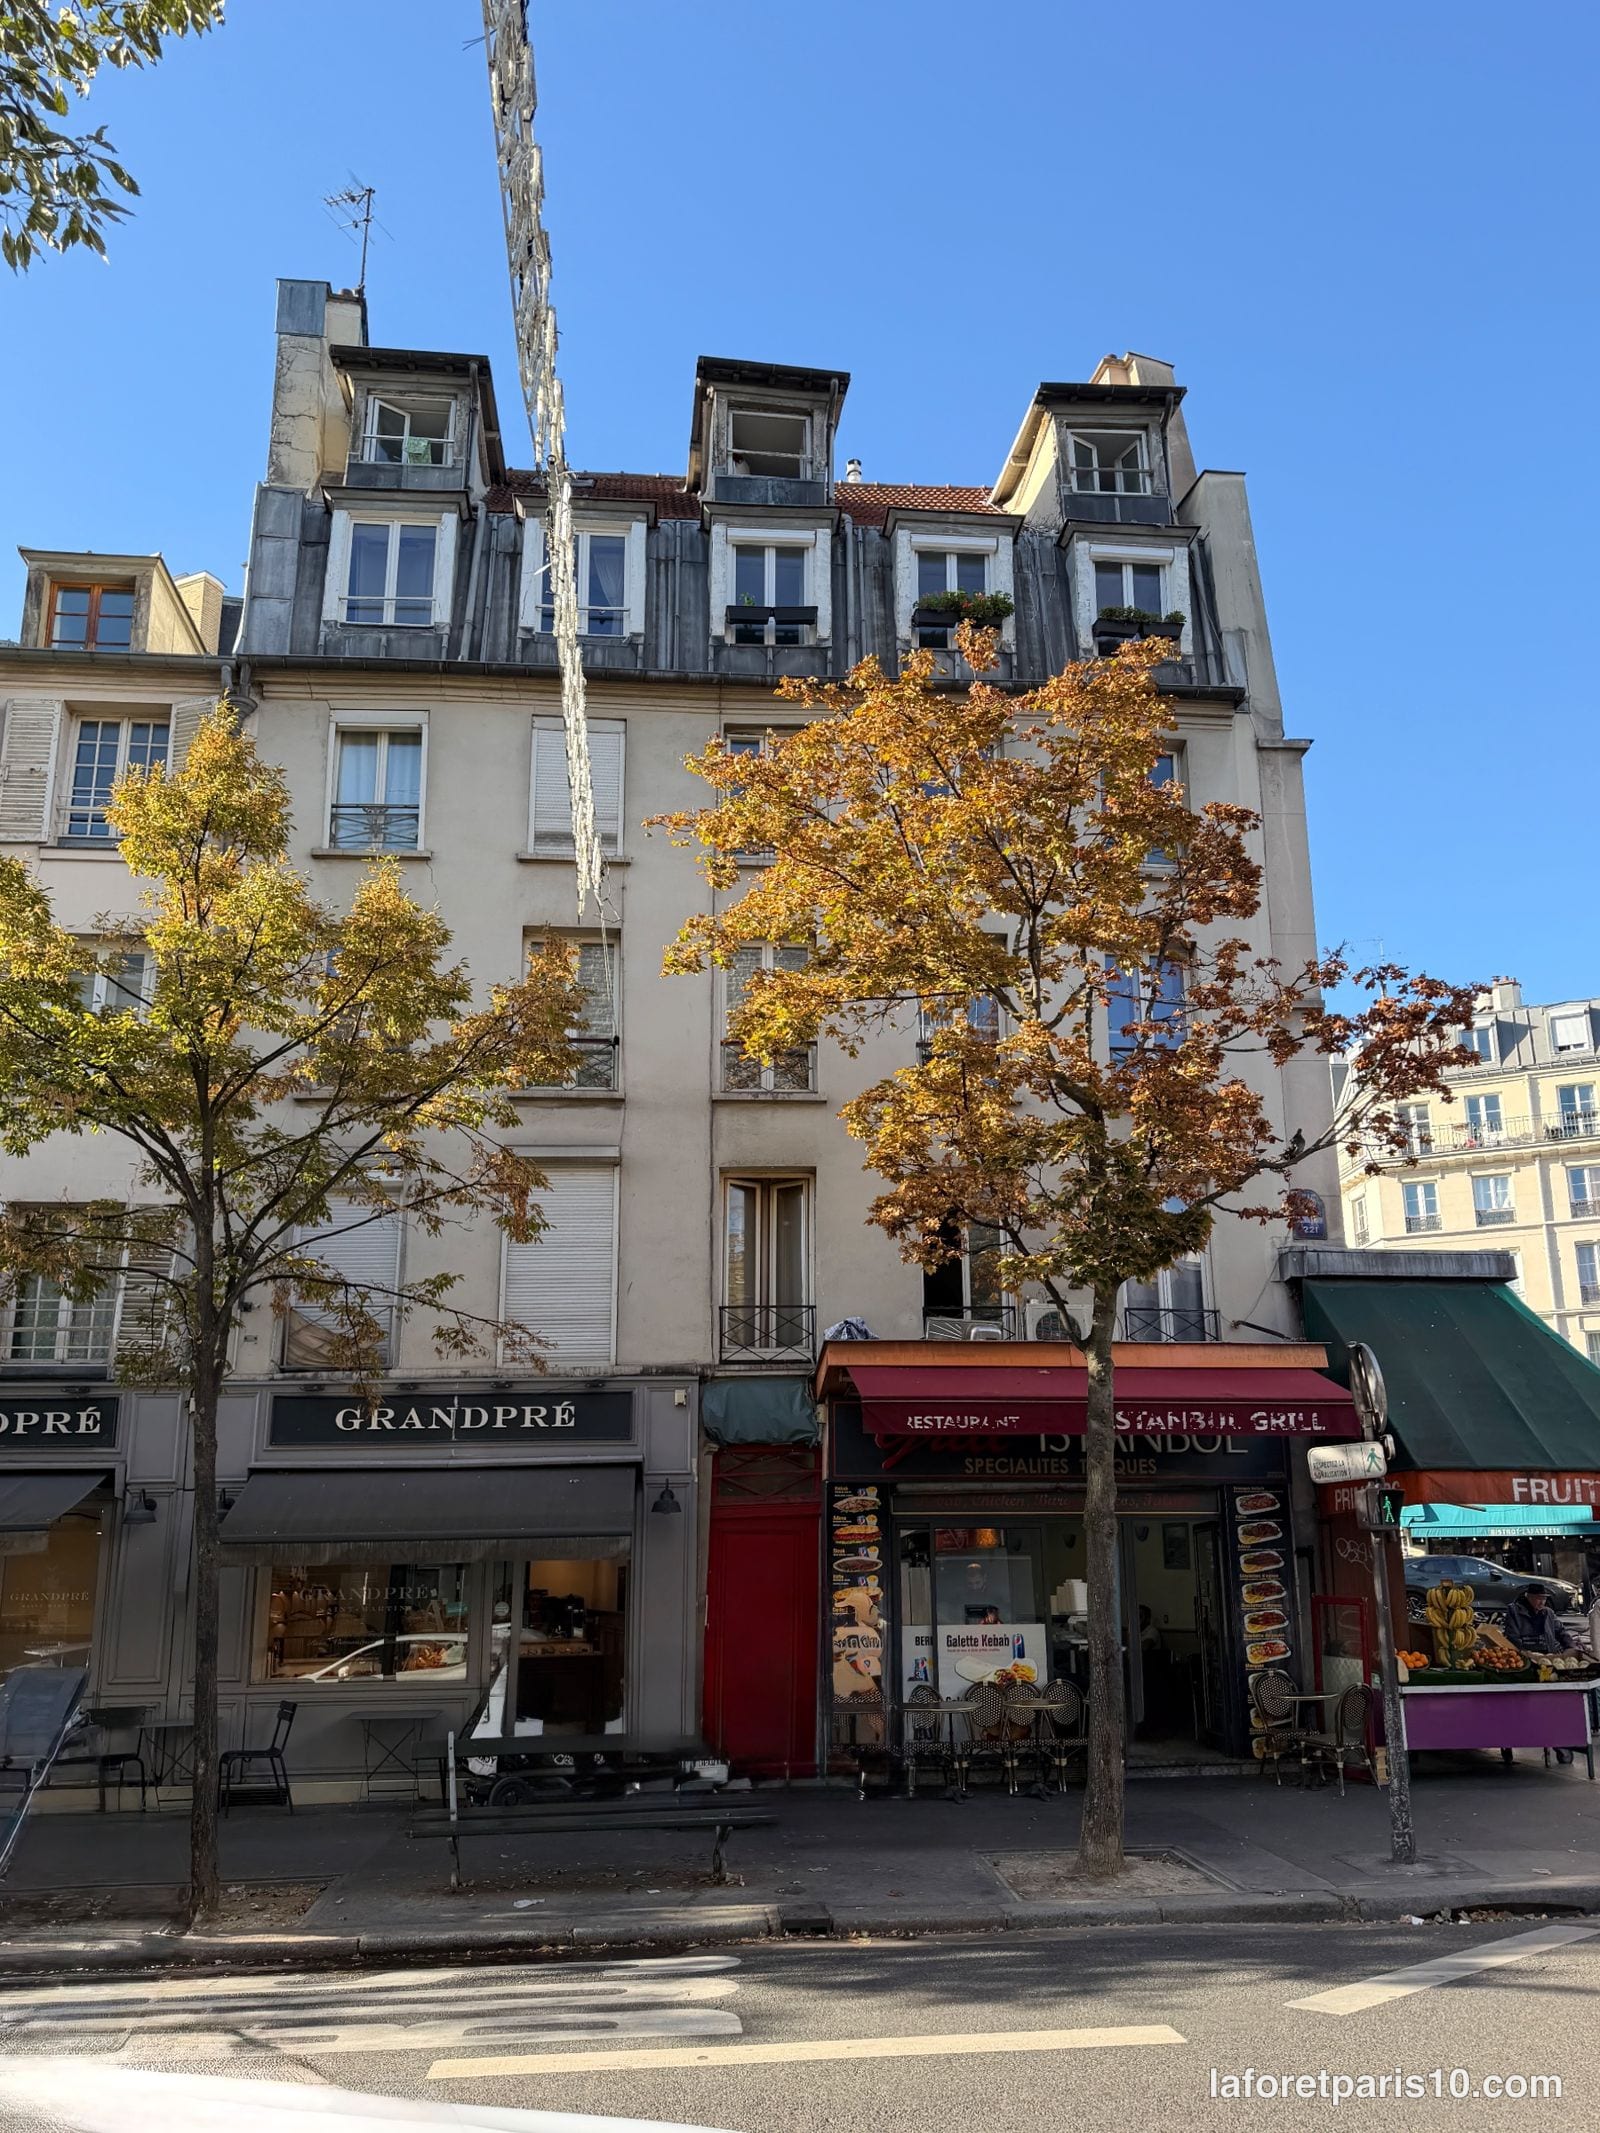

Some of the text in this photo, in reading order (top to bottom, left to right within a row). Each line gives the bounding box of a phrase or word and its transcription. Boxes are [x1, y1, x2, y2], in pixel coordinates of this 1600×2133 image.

[335, 1401, 576, 1431] GRANDPRÉ
[1114, 1411, 1327, 1431] STANBUL GRILL
[964, 1457, 1158, 1476] SPECIALITES TQUES
[9, 1591, 89, 1601] GRANDPRÉ
[300, 1584, 428, 1602] GRANDPRÉ
[946, 1634, 1010, 1648] Galette Kebab
